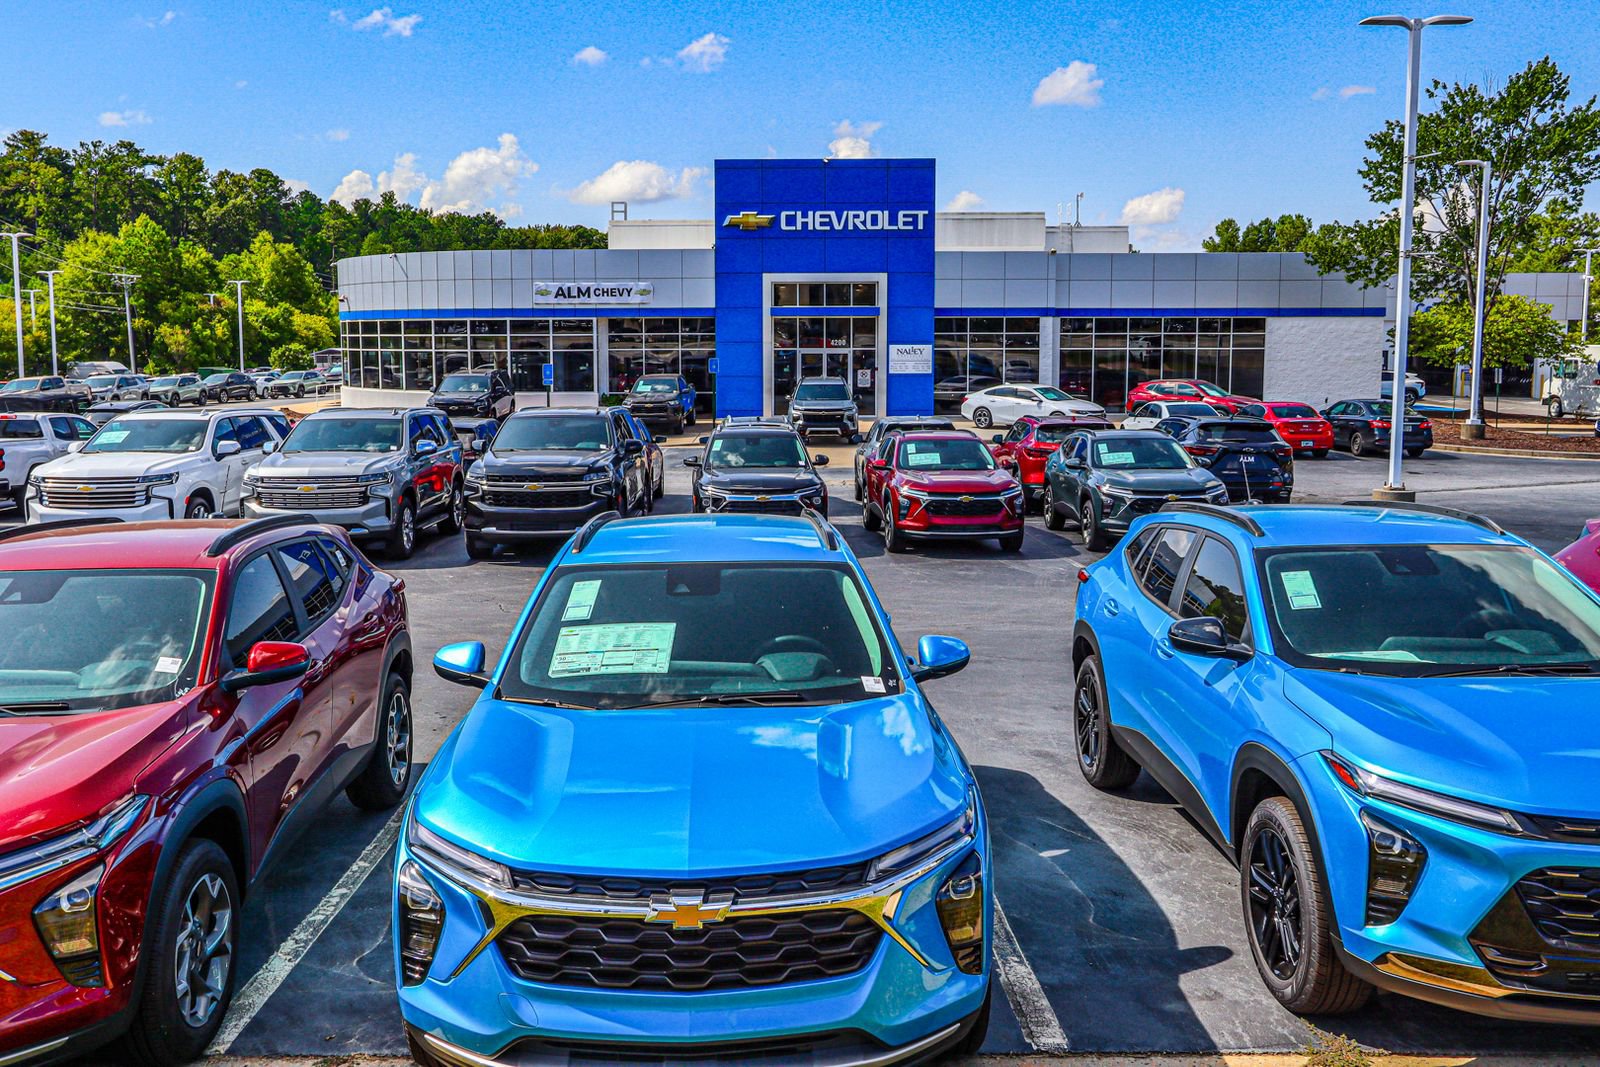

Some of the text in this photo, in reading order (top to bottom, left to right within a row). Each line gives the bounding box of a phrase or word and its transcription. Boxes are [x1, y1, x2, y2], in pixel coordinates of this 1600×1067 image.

[780, 210, 929, 231] CHEVROLET
[554, 286, 633, 299] ALM CHEVY
